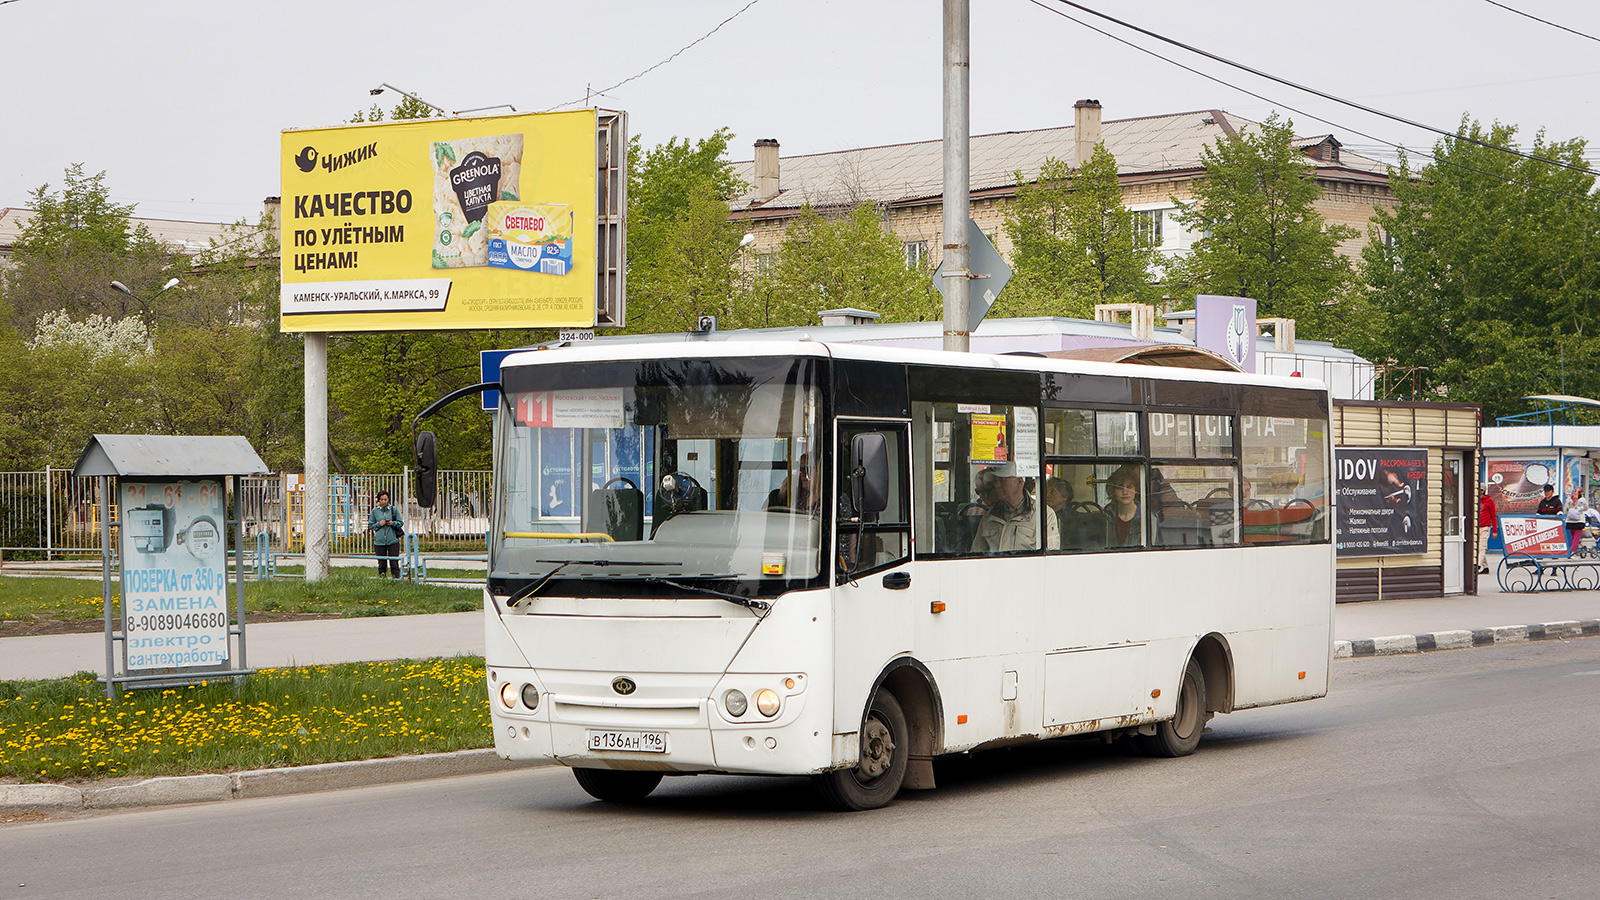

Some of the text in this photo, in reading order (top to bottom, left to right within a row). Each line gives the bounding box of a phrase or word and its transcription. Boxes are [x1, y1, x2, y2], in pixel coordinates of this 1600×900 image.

[452, 165, 499, 185] GREENOLA
[464, 184, 491, 199] ЦВЕТНАЯ
[465, 193, 492, 207] КАПУСТА
[294, 189, 412, 218] КАЧЕСТВО
[505, 215, 544, 231] СВЕТАЕВО
[294, 222, 404, 247] ПО УЛЁТНЫМ
[510, 245, 538, 258] МАСЛО
[294, 251, 358, 274] ЦЕНАМ!
[293, 289, 439, 303] КАМЕНСК-УРАЛЬСКИЙ, К.МАРКСА, 99
[561, 332, 594, 341] 324-000
[522, 392, 547, 422] 11
[1124, 412, 1276, 441] ДОРЕЦ СПРТА
[1338, 458, 1377, 480] IDOV
[1380, 459, 1410, 467] РАССРОЧКА
[1411, 459, 1421, 467] БЕЗ
[1406, 471, 1426, 479] КРЕДИТ
[127, 485, 146, 507] 31
[164, 485, 182, 508] 61
[199, 485, 218, 508] 61
[1342, 487, 1377, 496] Обслуживание
[1511, 539, 1529, 552] ТЕПЕРЬ
[1535, 528, 1560, 543] КАМЕНСКЕ
[124, 568, 223, 596] ПОВЕРКА от 350 р
[132, 596, 218, 612] ЗАМЕНА
[127, 612, 225, 632] 8-9089046680
[129, 635, 212, 648] электро
[128, 648, 226, 667] сантехработы
[594, 733, 662, 748] В136АН 196
